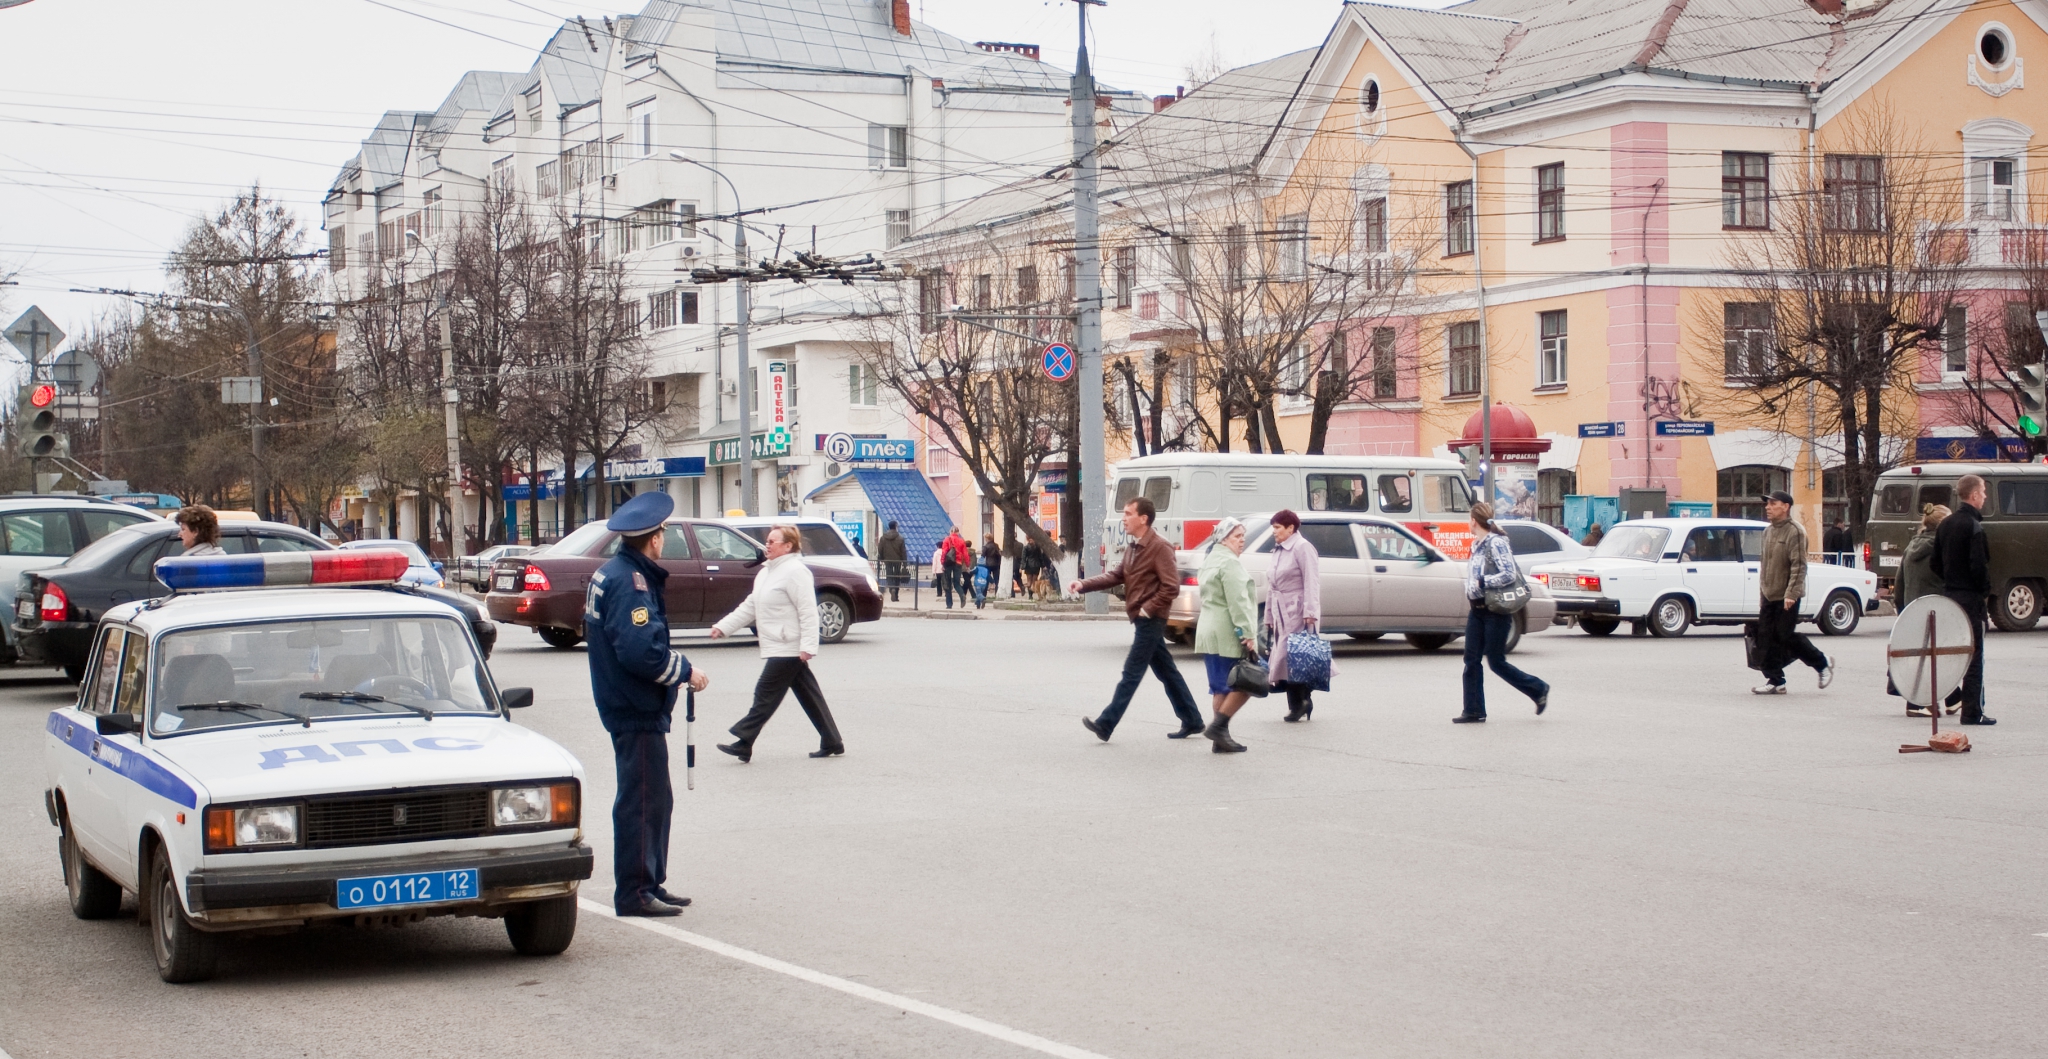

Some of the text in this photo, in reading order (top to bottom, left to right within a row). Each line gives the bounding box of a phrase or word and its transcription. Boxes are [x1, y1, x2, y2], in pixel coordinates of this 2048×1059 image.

[773, 375, 784, 423] АПТЕКА
[1617, 424, 1625, 434] 28
[1435, 539, 1463, 547] ГАЗЕТА
[257, 736, 485, 770] ДПС
[372, 876, 432, 903] 0112
[447, 872, 469, 890] 12
[450, 889, 468, 897] RUS
